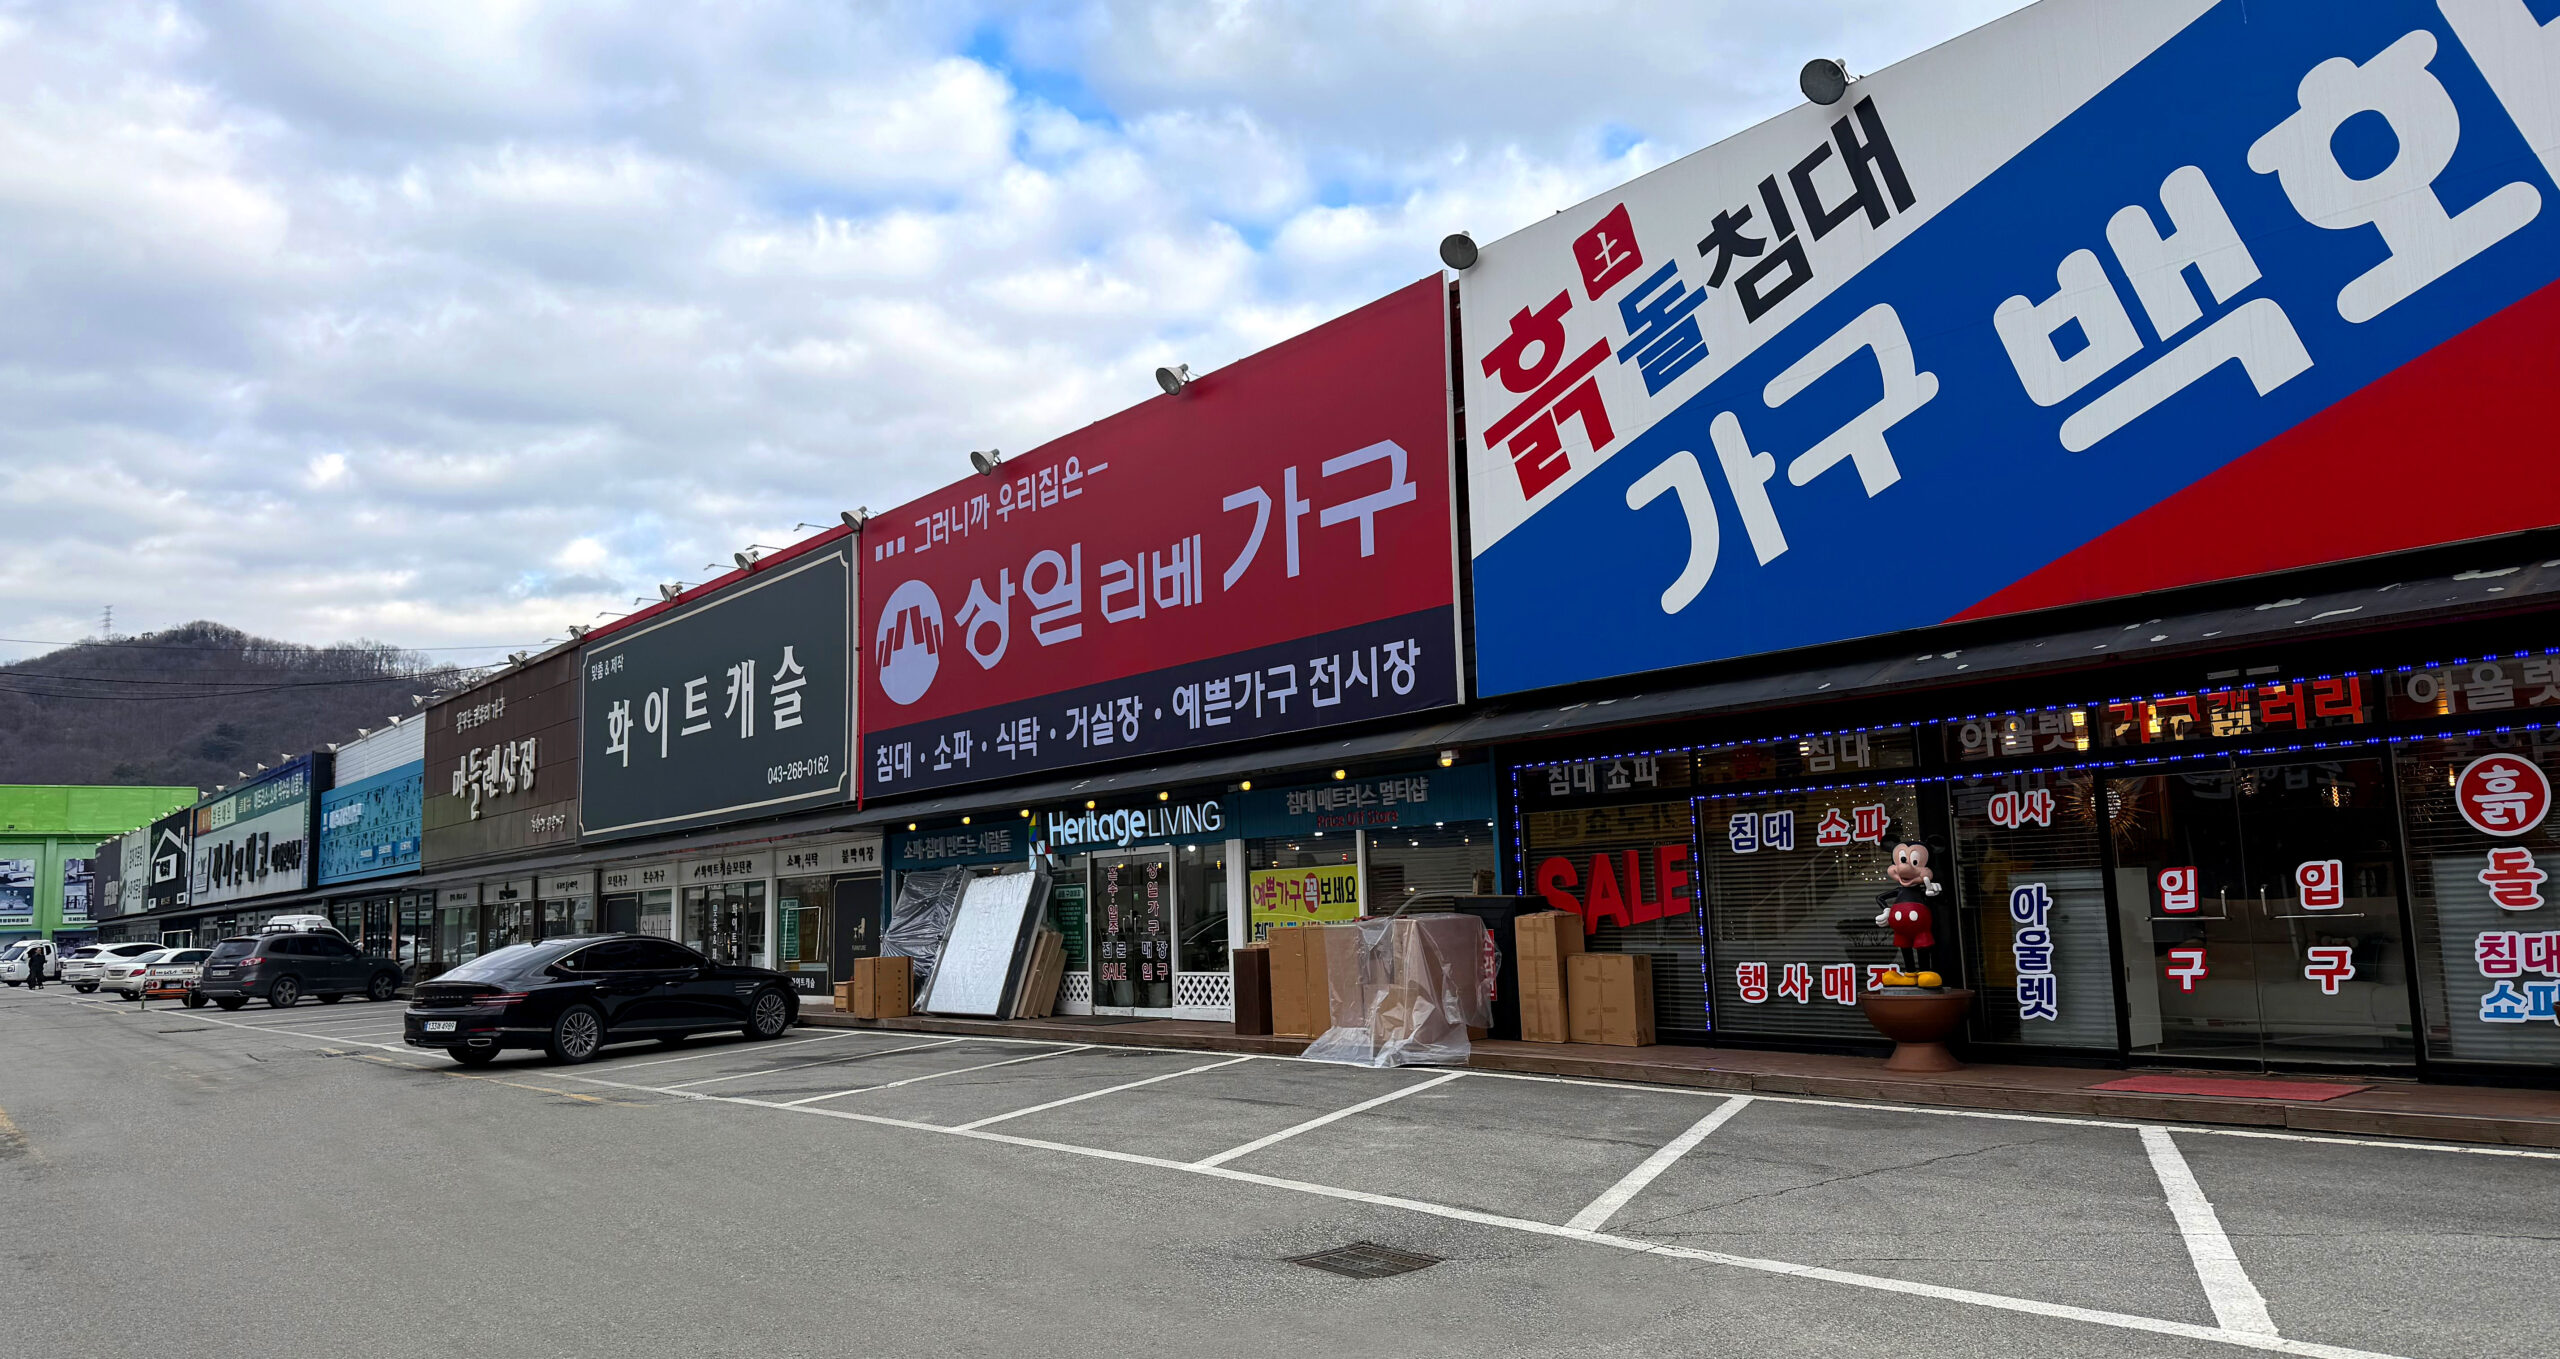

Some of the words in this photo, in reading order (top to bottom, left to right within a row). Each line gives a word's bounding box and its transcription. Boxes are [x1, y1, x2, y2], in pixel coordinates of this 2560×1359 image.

[1625, 302, 1940, 616] 가구
[914, 493, 990, 554] 그러니까
[955, 542, 1084, 670] 상일
[1101, 533, 1202, 624] 리베
[1223, 439, 1417, 592] 가구
[606, 645, 807, 768] 화이트캐슬
[876, 742, 912, 783] 침대
[933, 729, 973, 772] 소파
[997, 716, 1040, 760] 식탁
[1066, 696, 1142, 749] 거실장
[1173, 664, 1298, 729] 예쁜가구
[1310, 638, 1420, 708] 전시장
[768, 754, 829, 784] 043-268-0162
[1806, 733, 1870, 773] 침대
[1548, 763, 1596, 796] 침대
[1607, 755, 1660, 790] 쇼파
[1287, 789, 1317, 816] 침대
[1317, 784, 1378, 811] 매트리스
[1379, 776, 1429, 806] 멀티샵
[1988, 788, 2055, 828] 이사
[1317, 814, 1344, 828] Price
[1347, 811, 1365, 826] Off
[1367, 809, 1398, 824] Store
[1729, 810, 1794, 853] 침대
[1816, 803, 1891, 847] 쇼파
[978, 829, 1013, 854] 사람들
[1253, 876, 1302, 911] 예쁜가구
[1321, 876, 1357, 905] 보세요
[1536, 844, 1691, 935] SALE
[1102, 941, 1127, 959] 전문
[1142, 940, 1168, 959] 매장
[1102, 962, 1127, 981] SALE
[1142, 962, 1168, 981] 입구
